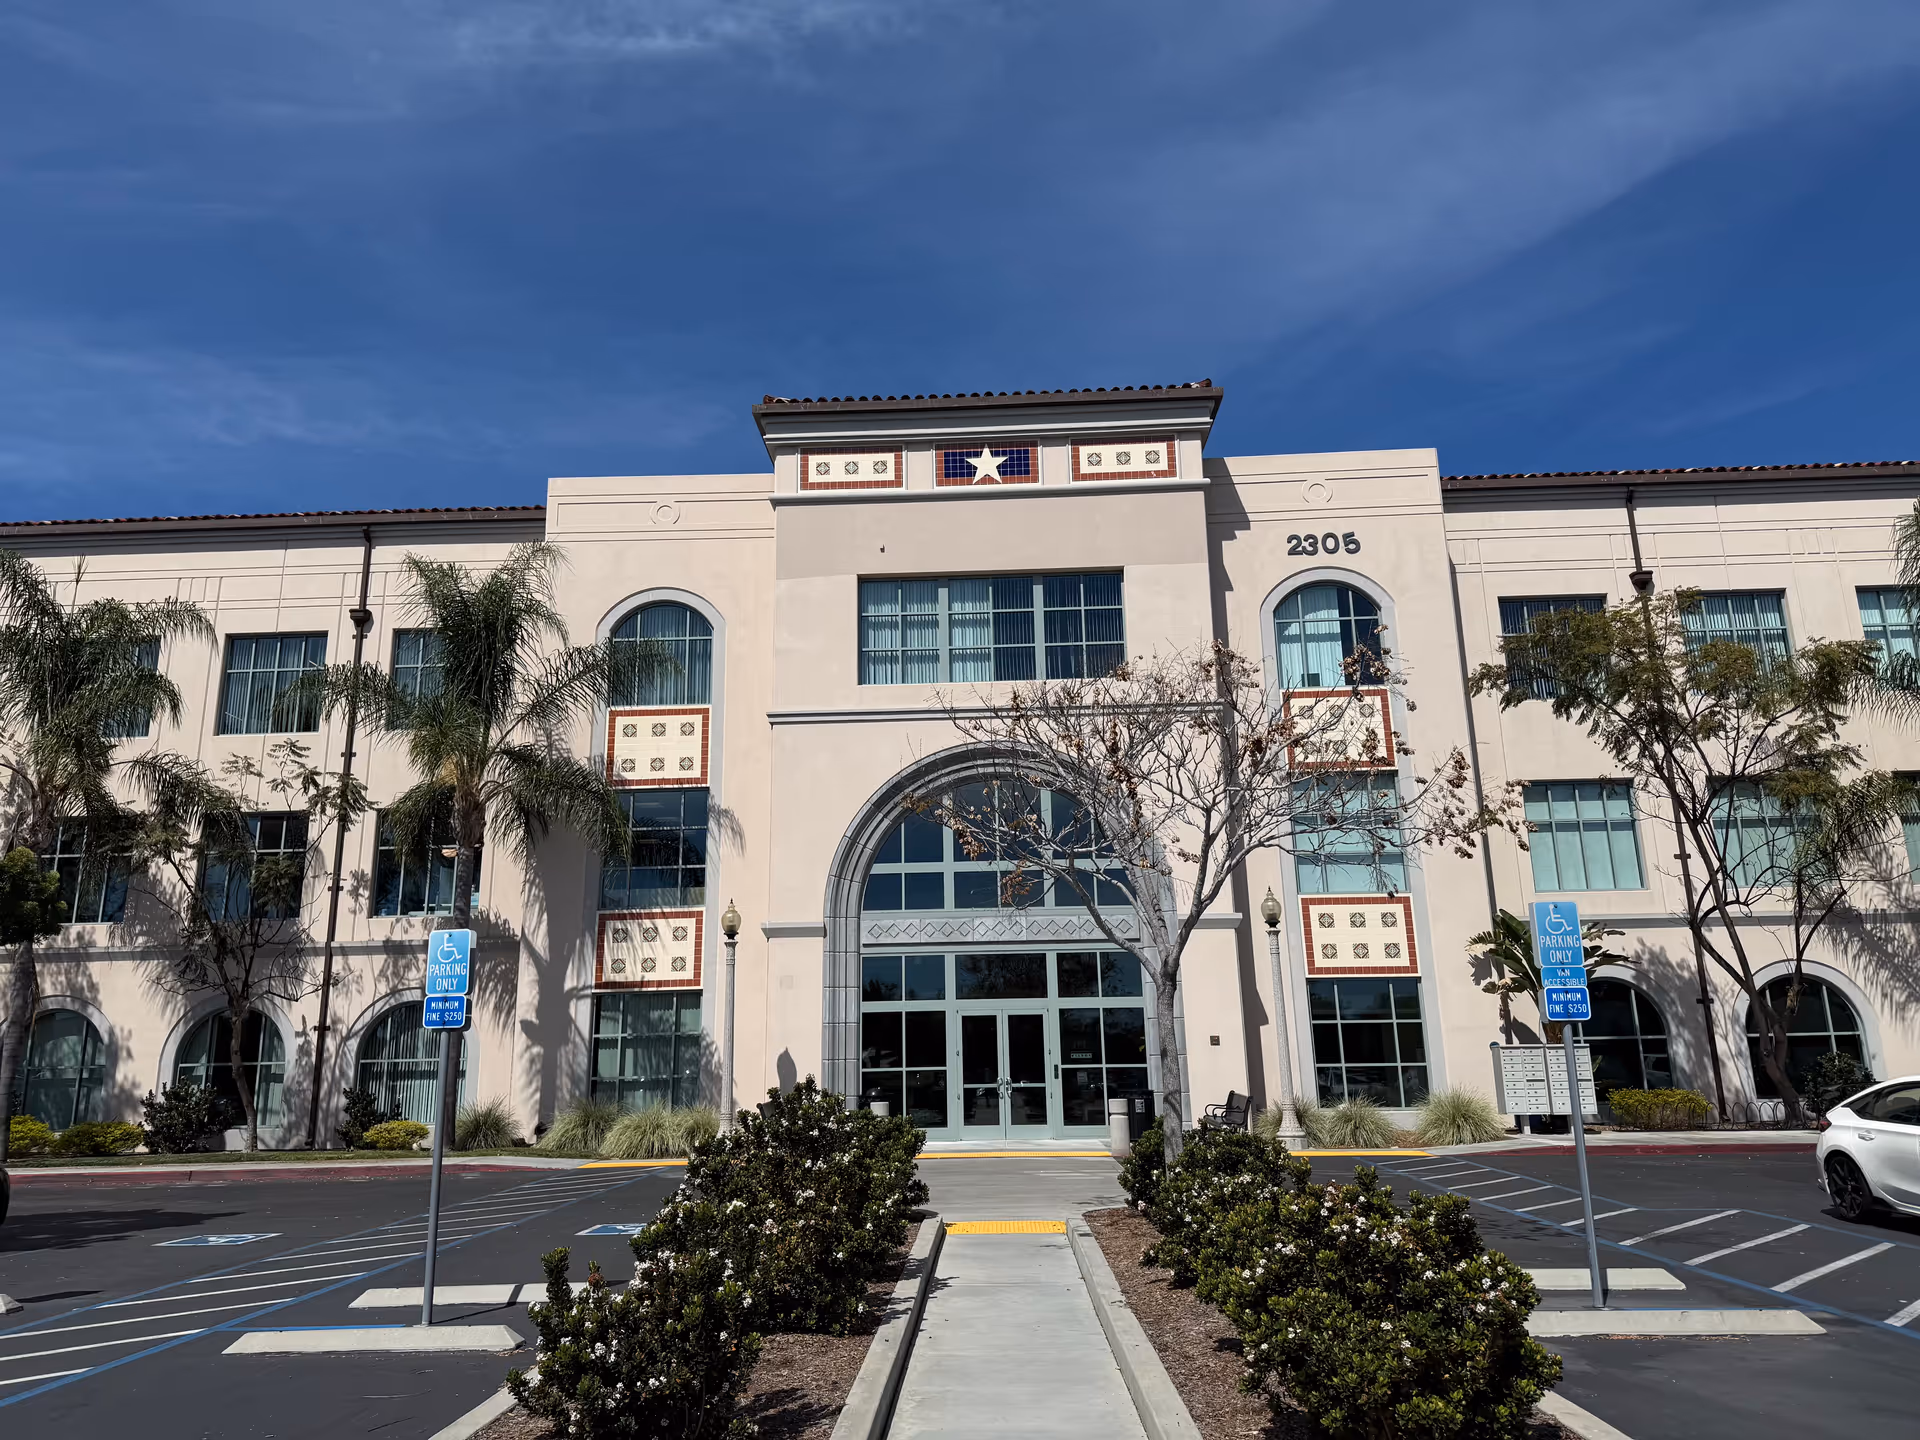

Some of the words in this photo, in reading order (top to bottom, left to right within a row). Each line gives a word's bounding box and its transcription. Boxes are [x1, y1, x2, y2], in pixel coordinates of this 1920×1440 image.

[1287, 531, 1361, 556] 2305
[1540, 935, 1580, 948] PARKING
[1550, 950, 1573, 963] ONLY
[429, 963, 467, 976] PARKING
[436, 978, 458, 991] ONLY
[1544, 978, 1585, 986] ACCESSIBLE
[1552, 992, 1582, 1001] MINIMUM
[431, 1000, 459, 1010] MINIMUM
[1549, 1004, 1564, 1013] FINE
[1568, 1003, 1587, 1013] $250
[426, 1012, 440, 1021] FINE
[443, 1011, 462, 1021] $250
